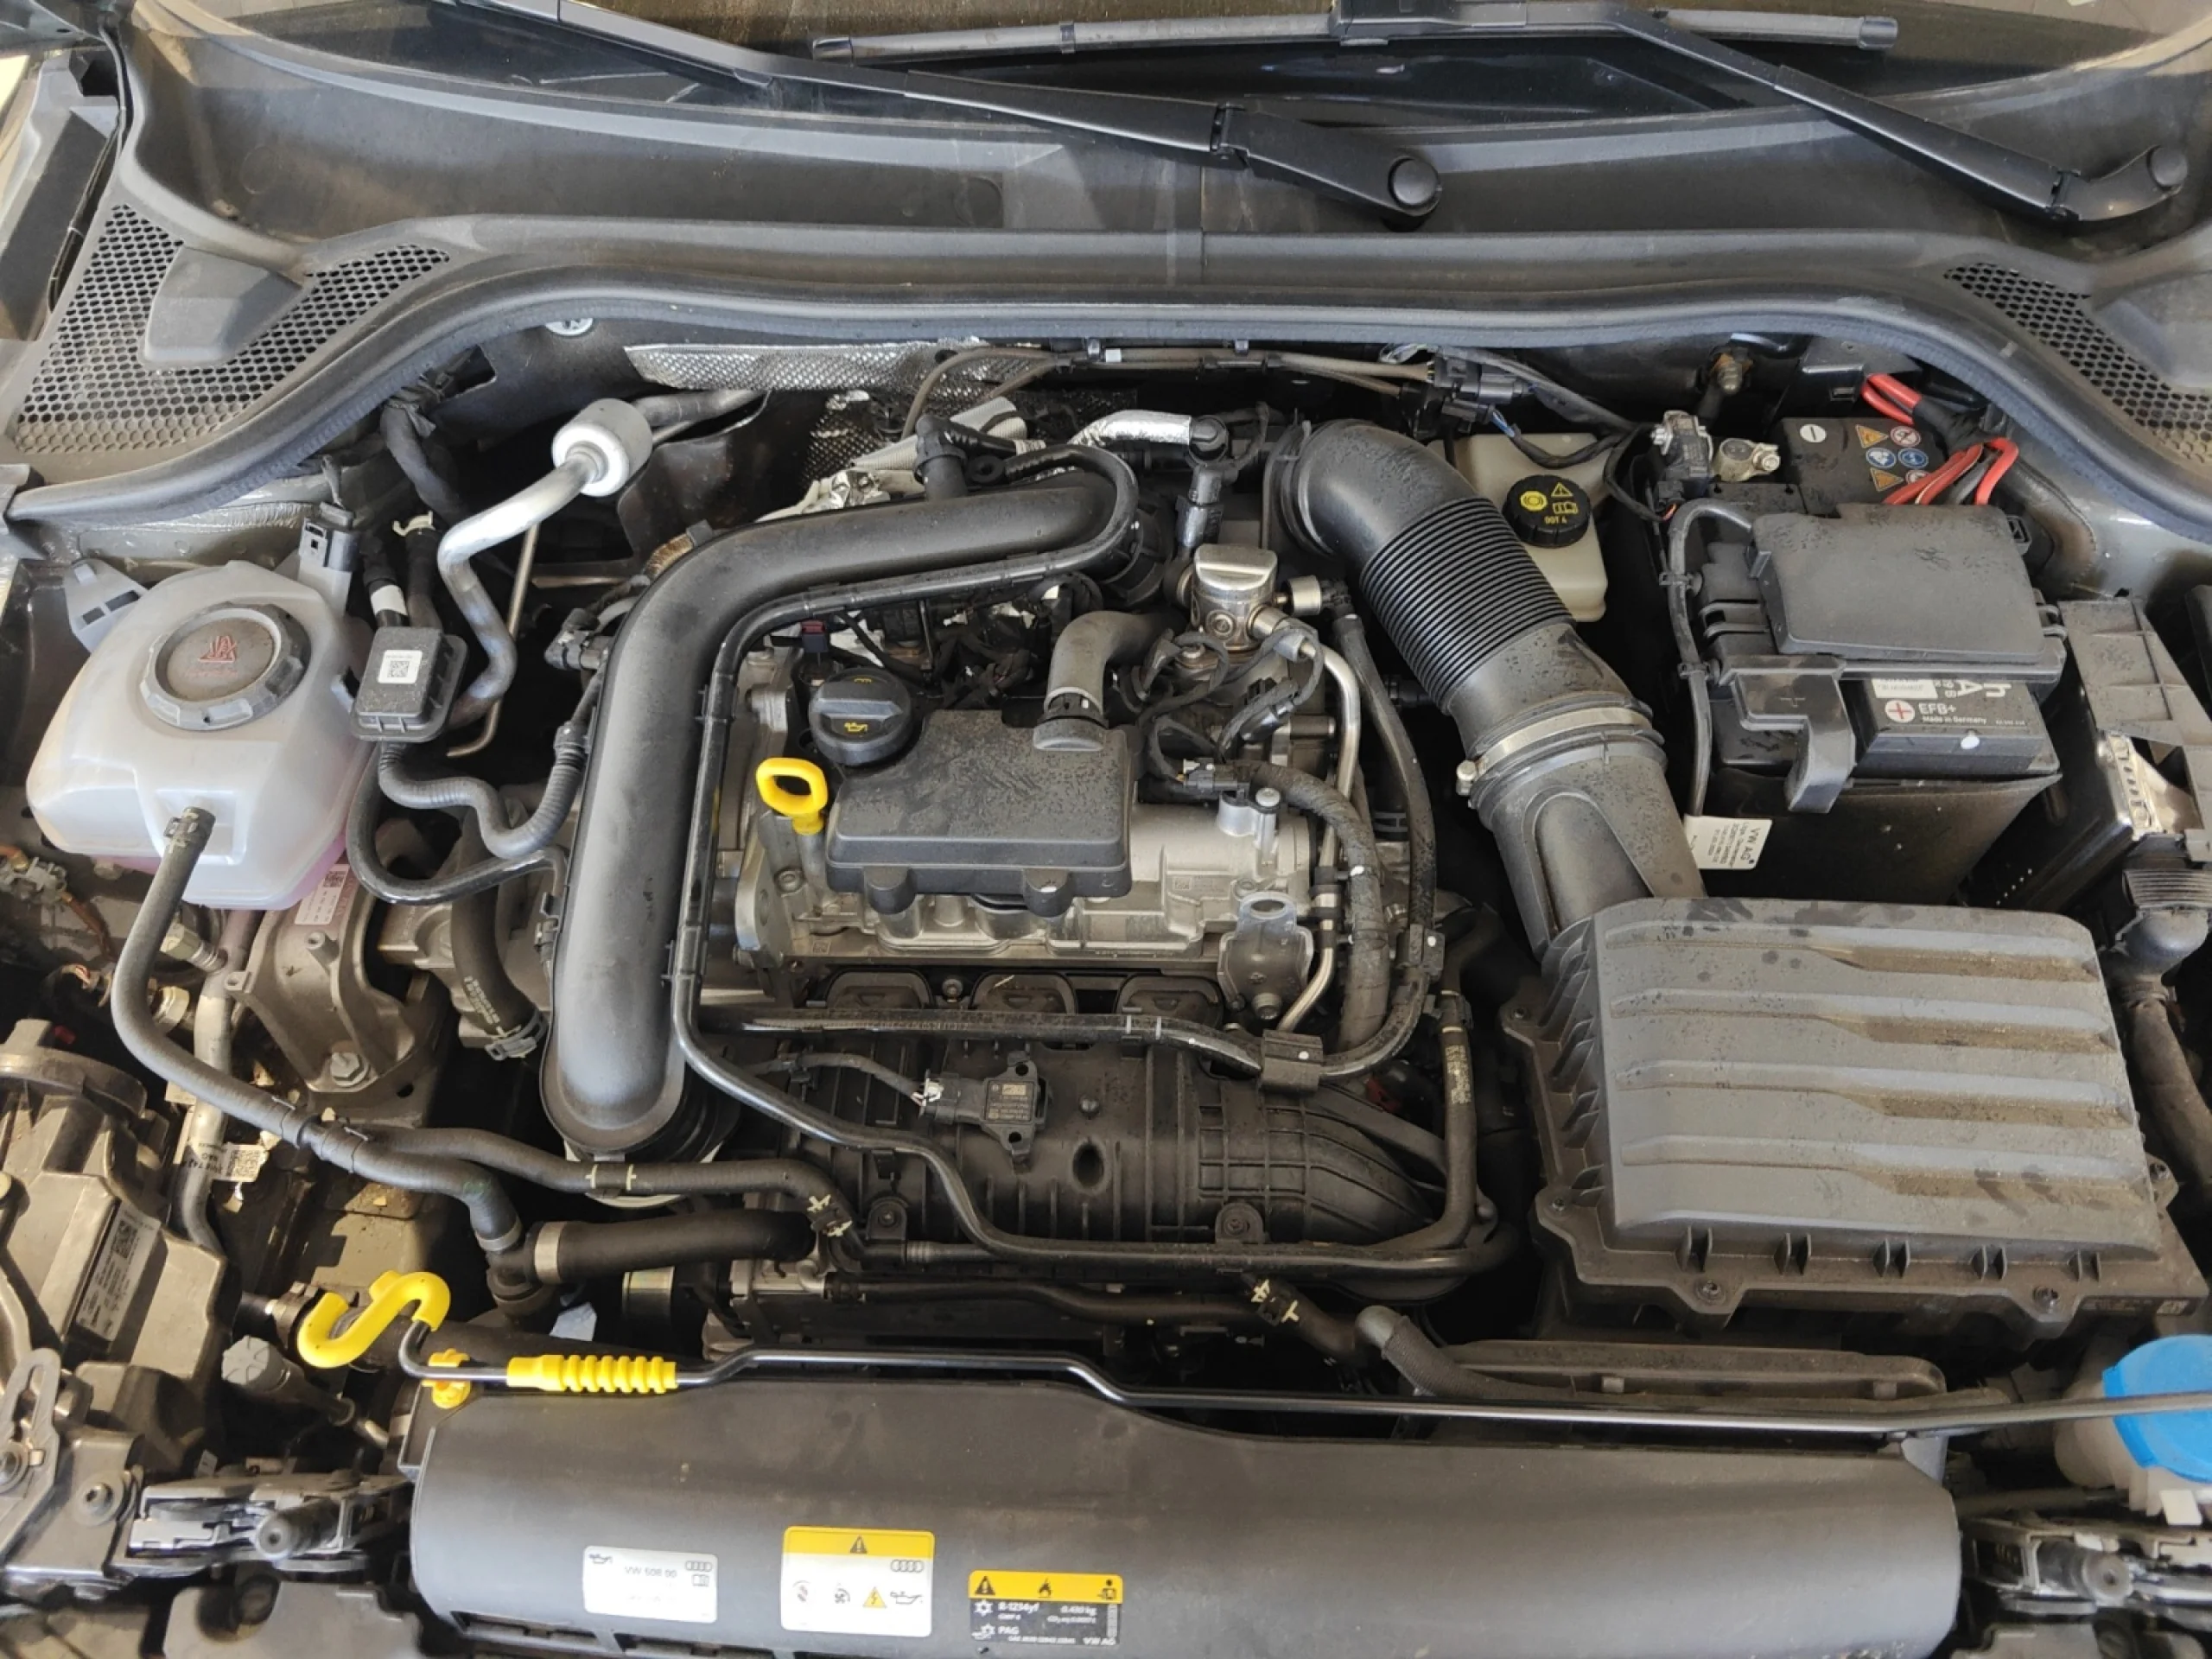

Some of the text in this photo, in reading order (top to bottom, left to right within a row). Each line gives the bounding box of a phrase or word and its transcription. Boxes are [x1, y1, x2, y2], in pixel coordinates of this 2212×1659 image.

[1544, 515, 1567, 524] DOT 4
[1918, 702, 1957, 715] EFB+
[1953, 716, 1987, 725] Germany
[998, 1602, 1039, 1614] R-1234yf
[998, 1625, 1020, 1635] PAG
